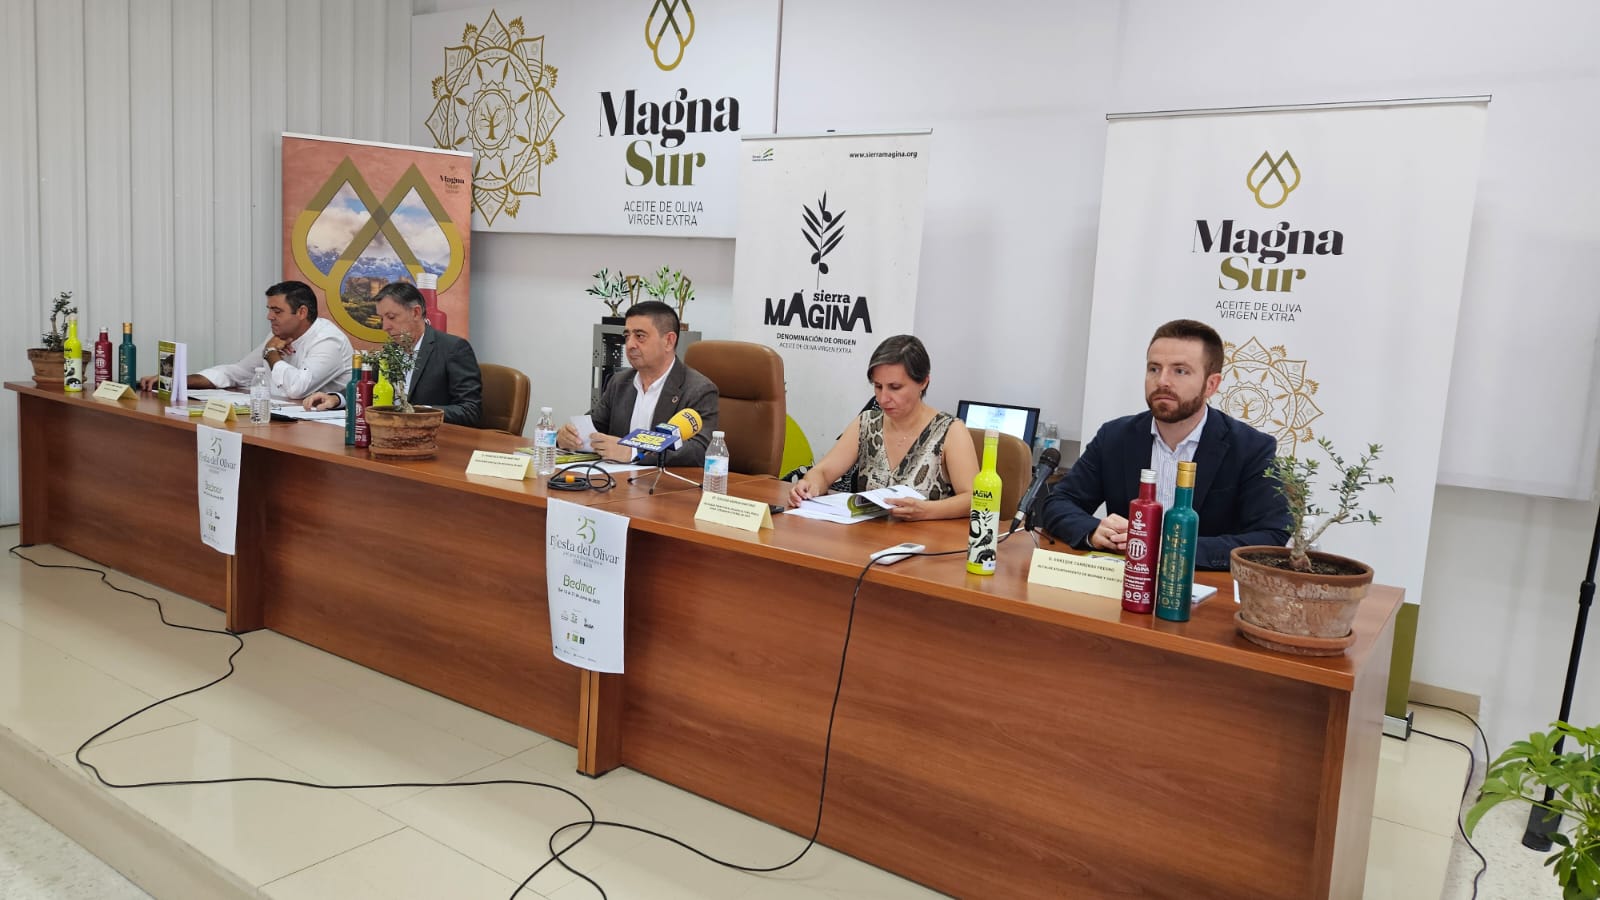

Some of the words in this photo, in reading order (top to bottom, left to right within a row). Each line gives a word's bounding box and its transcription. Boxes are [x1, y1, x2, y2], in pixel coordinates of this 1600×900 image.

[597, 88, 740, 148] Magna
[849, 150, 918, 158] www.sierramagina.org
[625, 140, 706, 187] Sur
[624, 201, 657, 212] ACEITE
[659, 201, 672, 212] DE
[675, 201, 704, 213] OLIVA
[628, 214, 663, 225] VIRGEN
[666, 215, 698, 226] EXTRA
[1192, 219, 1344, 264] Magna
[1218, 256, 1307, 292] Sur
[813, 289, 851, 303] sierra
[1215, 300, 1251, 311] ACEITE
[1253, 302, 1268, 312] DE
[1271, 303, 1302, 313] OLIVA
[1220, 310, 1258, 321] VIRGEN
[1261, 312, 1295, 322] EXTRA
[776, 332, 823, 343] DENOMINACIÓN
[833, 337, 857, 346] ORIGEN
[576, 517, 596, 545] 25
[577, 543, 591, 557] del
[593, 547, 620, 565] Olivar
[562, 574, 597, 596] Bedmar
